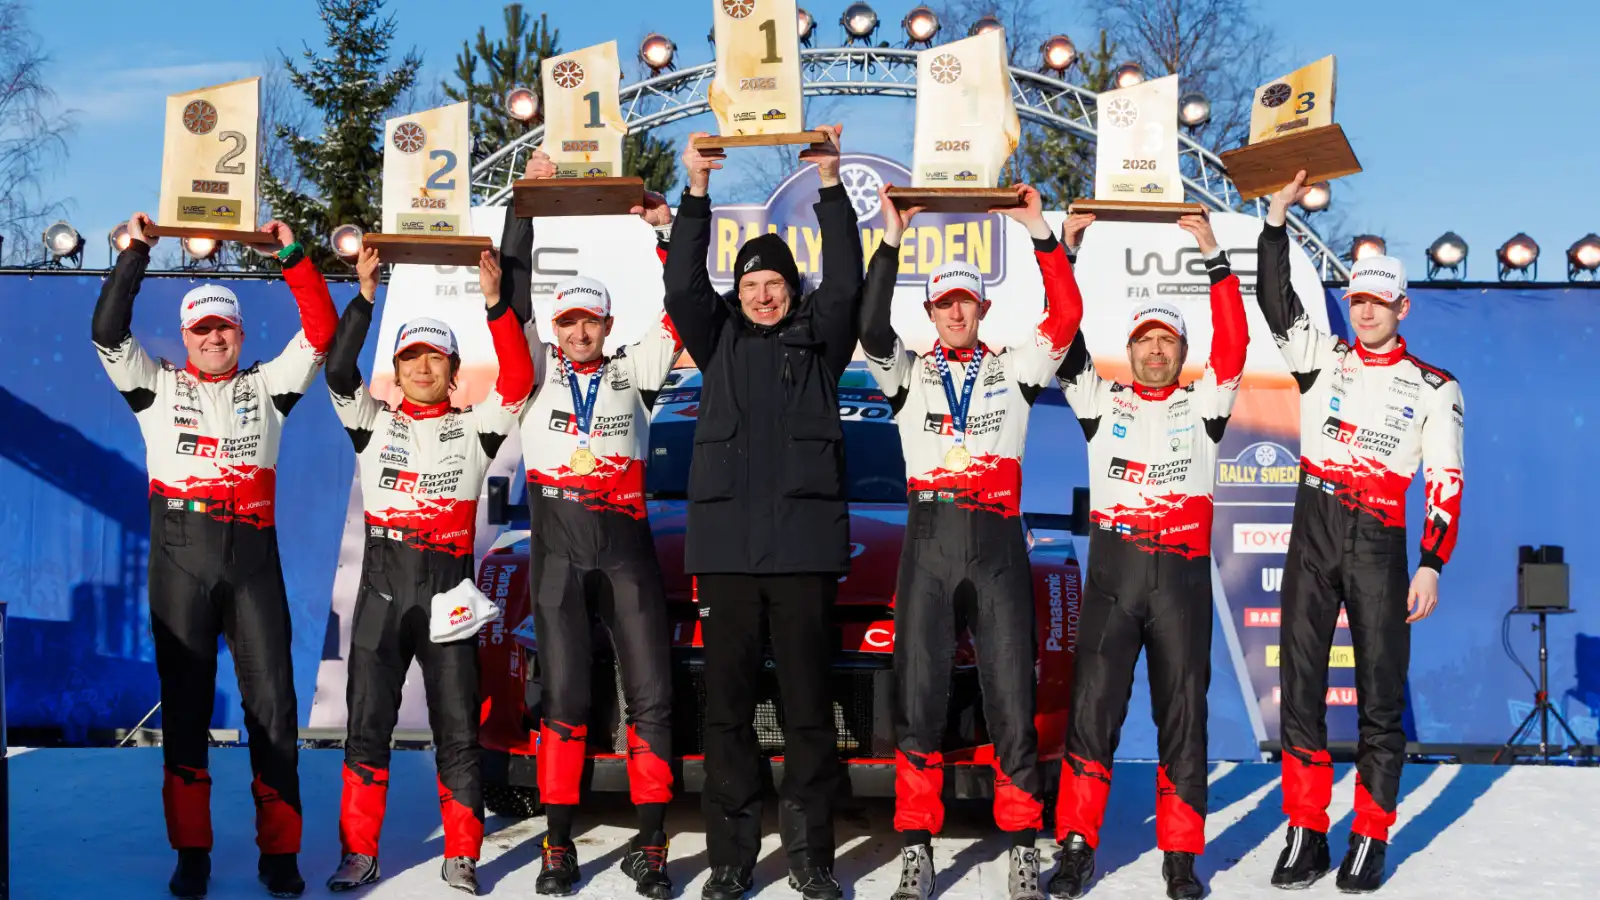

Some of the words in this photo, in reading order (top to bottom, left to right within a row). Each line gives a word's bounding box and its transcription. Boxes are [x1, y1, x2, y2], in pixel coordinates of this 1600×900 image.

[758, 18, 784, 65] 1
[740, 76, 777, 92] 2026
[1295, 91, 1316, 115] 3
[583, 90, 606, 129] 1
[562, 140, 599, 152] 2026
[935, 140, 971, 152] 2026
[215, 130, 247, 175] 2
[426, 149, 458, 190] 2
[1122, 159, 1157, 170] 2026
[192, 180, 229, 194] 2026
[411, 197, 447, 209] 2026
[595, 413, 634, 423] TOYOTA
[967, 409, 1006, 422] TOYOTA
[593, 422, 630, 430] GAZOO
[966, 418, 1002, 429] GAZOO
[595, 430, 629, 438] Racing
[965, 425, 1000, 437] Racing
[1322, 424, 1353, 444] GR
[1360, 429, 1401, 444] TOYOTA
[177, 442, 218, 459] GR
[221, 434, 262, 447] TOYOTA
[221, 443, 258, 453] GAZOO
[1357, 436, 1396, 449] GAZOO
[1353, 442, 1392, 457] Racing
[220, 451, 256, 461] Racing
[379, 452, 409, 465] MAEDA
[1109, 465, 1145, 484] GR
[1149, 458, 1192, 471] TOYOTA
[1148, 467, 1188, 478] GAZOO
[1219, 464, 1257, 483] RALLY
[379, 476, 417, 494] GR
[421, 469, 464, 481] TOYOTA
[420, 477, 459, 488] GAZOO
[1146, 474, 1187, 486] Racing
[418, 485, 458, 496] Racing
[542, 487, 559, 497] OMP
[994, 489, 1012, 498] EVANS
[167, 500, 184, 509] OMP
[441, 529, 469, 540] KATSUTA
[1160, 527, 1169, 536] M.
[1169, 522, 1200, 534] SALMINEN
[490, 564, 518, 645] Panasonic
[1044, 573, 1063, 651] Panasonic
